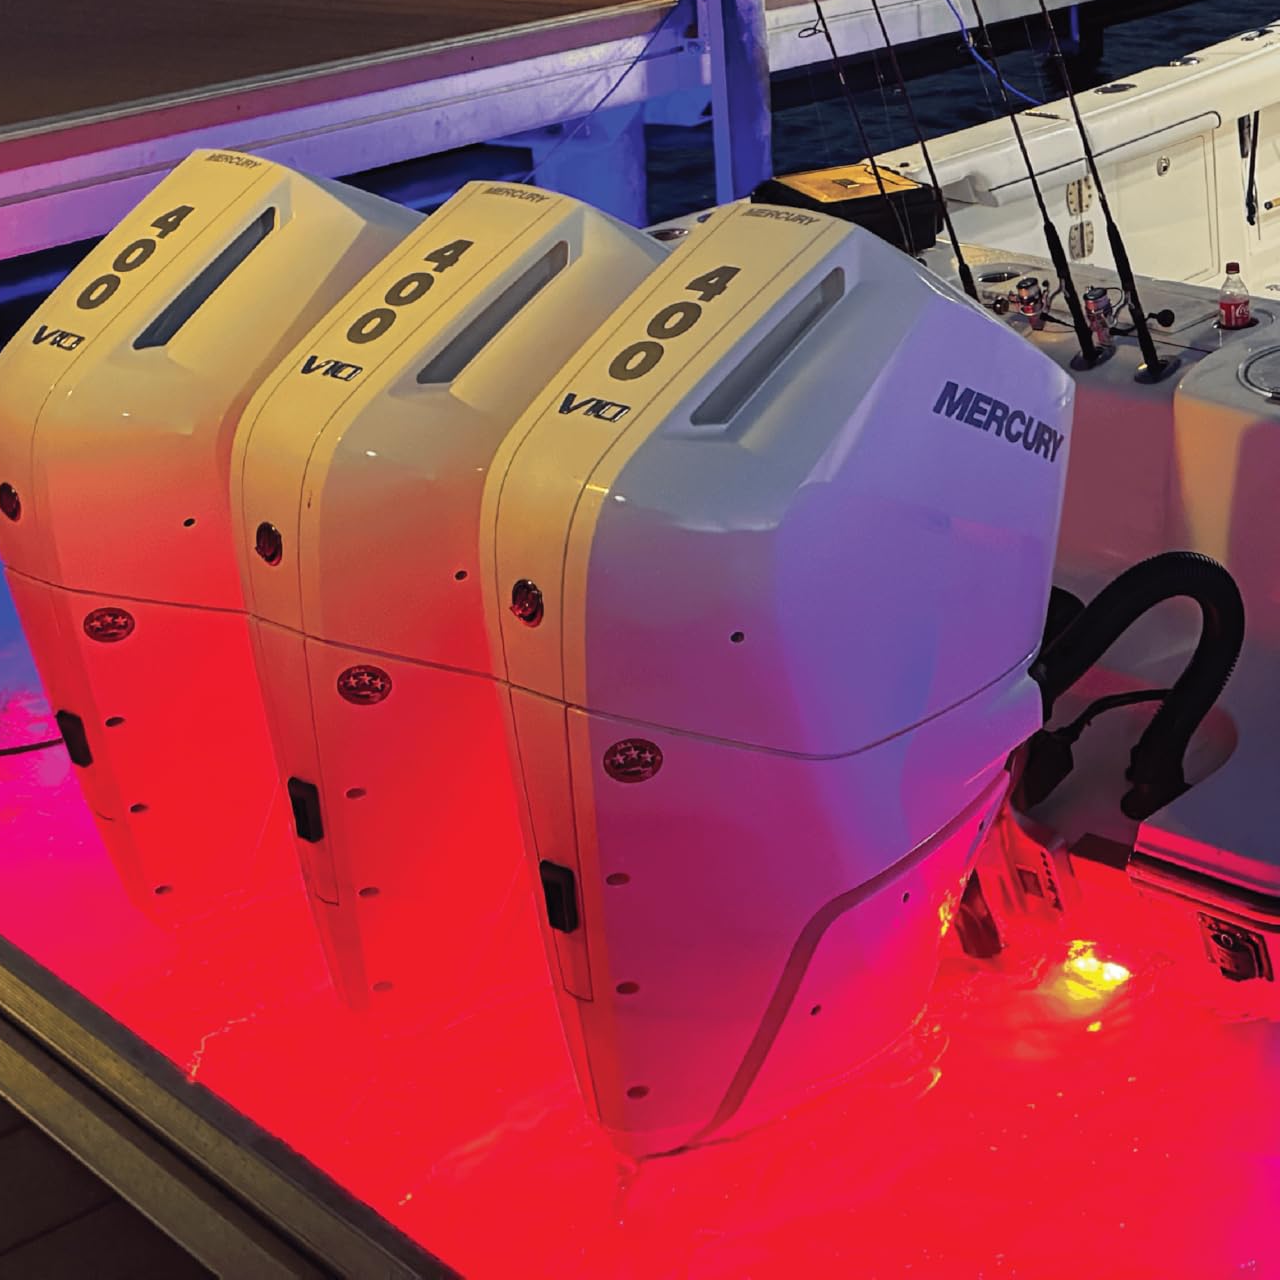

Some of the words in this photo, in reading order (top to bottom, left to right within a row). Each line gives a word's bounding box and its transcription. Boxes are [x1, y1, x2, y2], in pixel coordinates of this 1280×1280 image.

[742, 207, 821, 226] MERCURY
[32, 324, 86, 351] V10
[300, 354, 364, 382] V10
[558, 392, 632, 422] V10
[932, 380, 1065, 463] MERCURY
